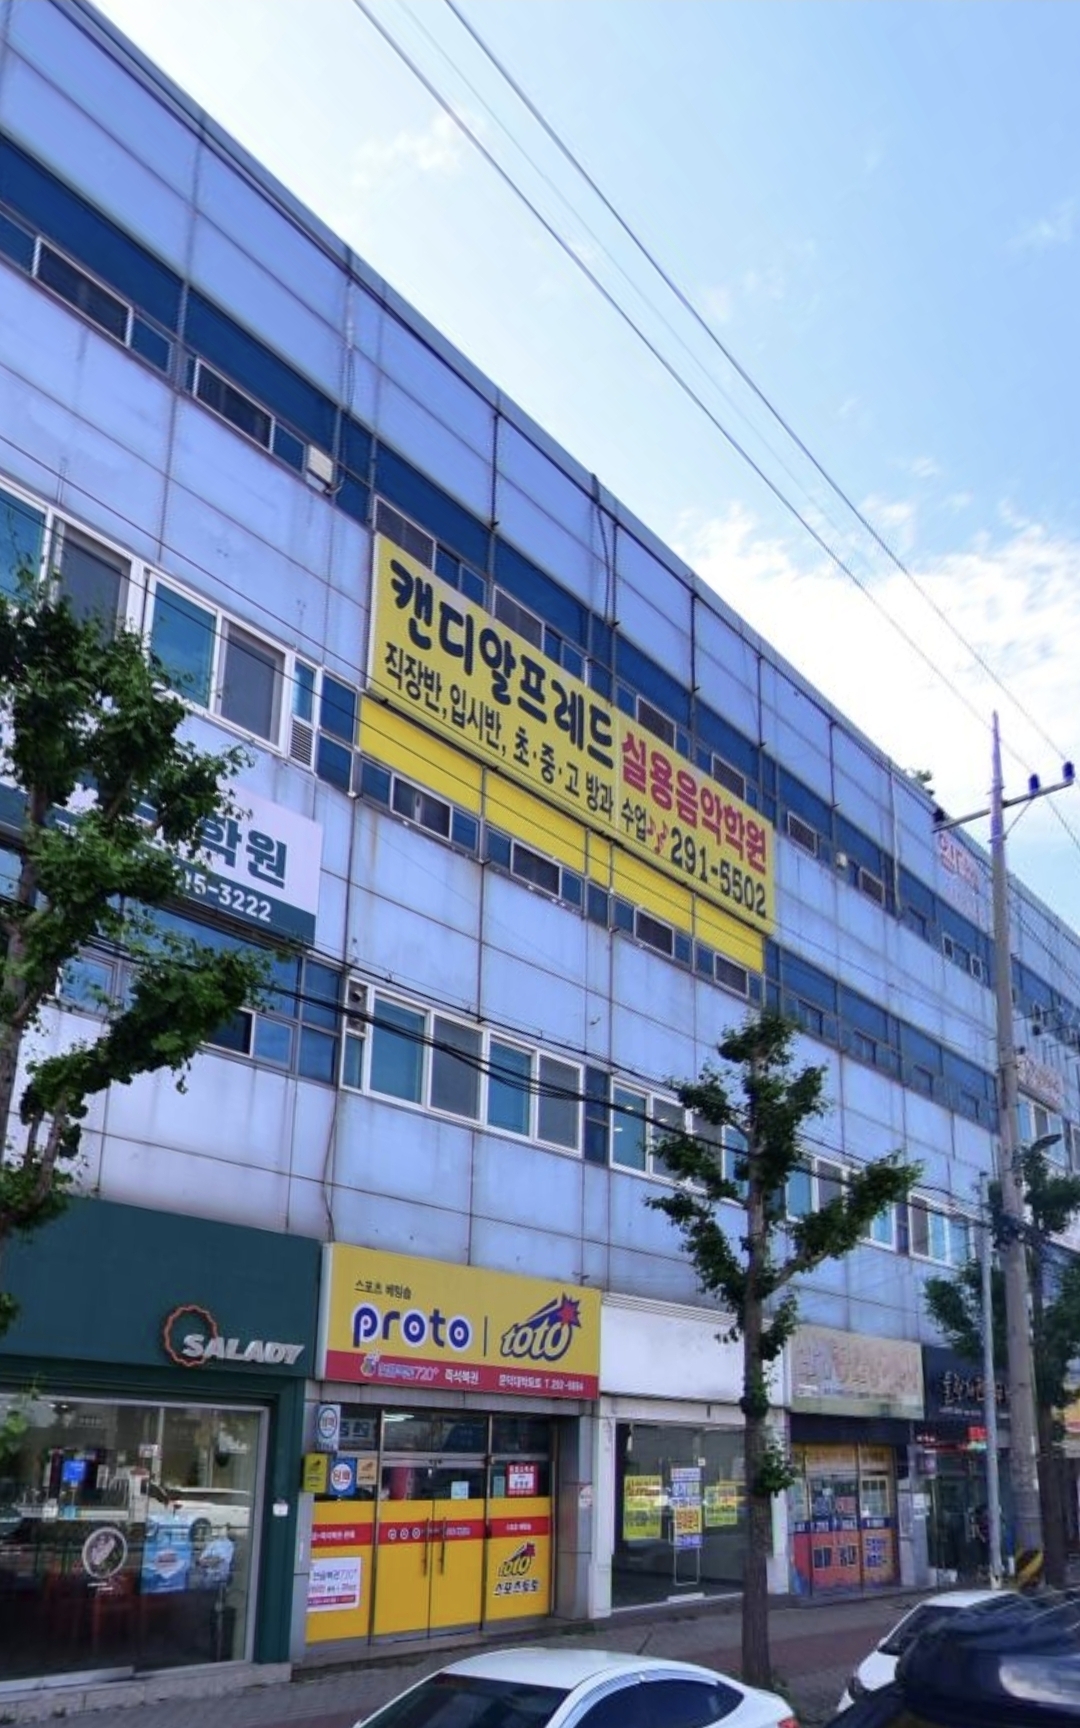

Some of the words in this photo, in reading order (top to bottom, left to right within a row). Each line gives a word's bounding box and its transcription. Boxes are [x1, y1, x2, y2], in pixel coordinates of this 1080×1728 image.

[390, 558, 615, 770] 캔디알프레드
[621, 730, 768, 876] 실용음악학원
[584, 772, 615, 823] 방과
[621, 800, 649, 843] 수업
[670, 828, 768, 920] 291-5502
[182, 1333, 305, 1365] SALADY
[352, 1302, 473, 1351] proto
[500, 1312, 576, 1362] toto
